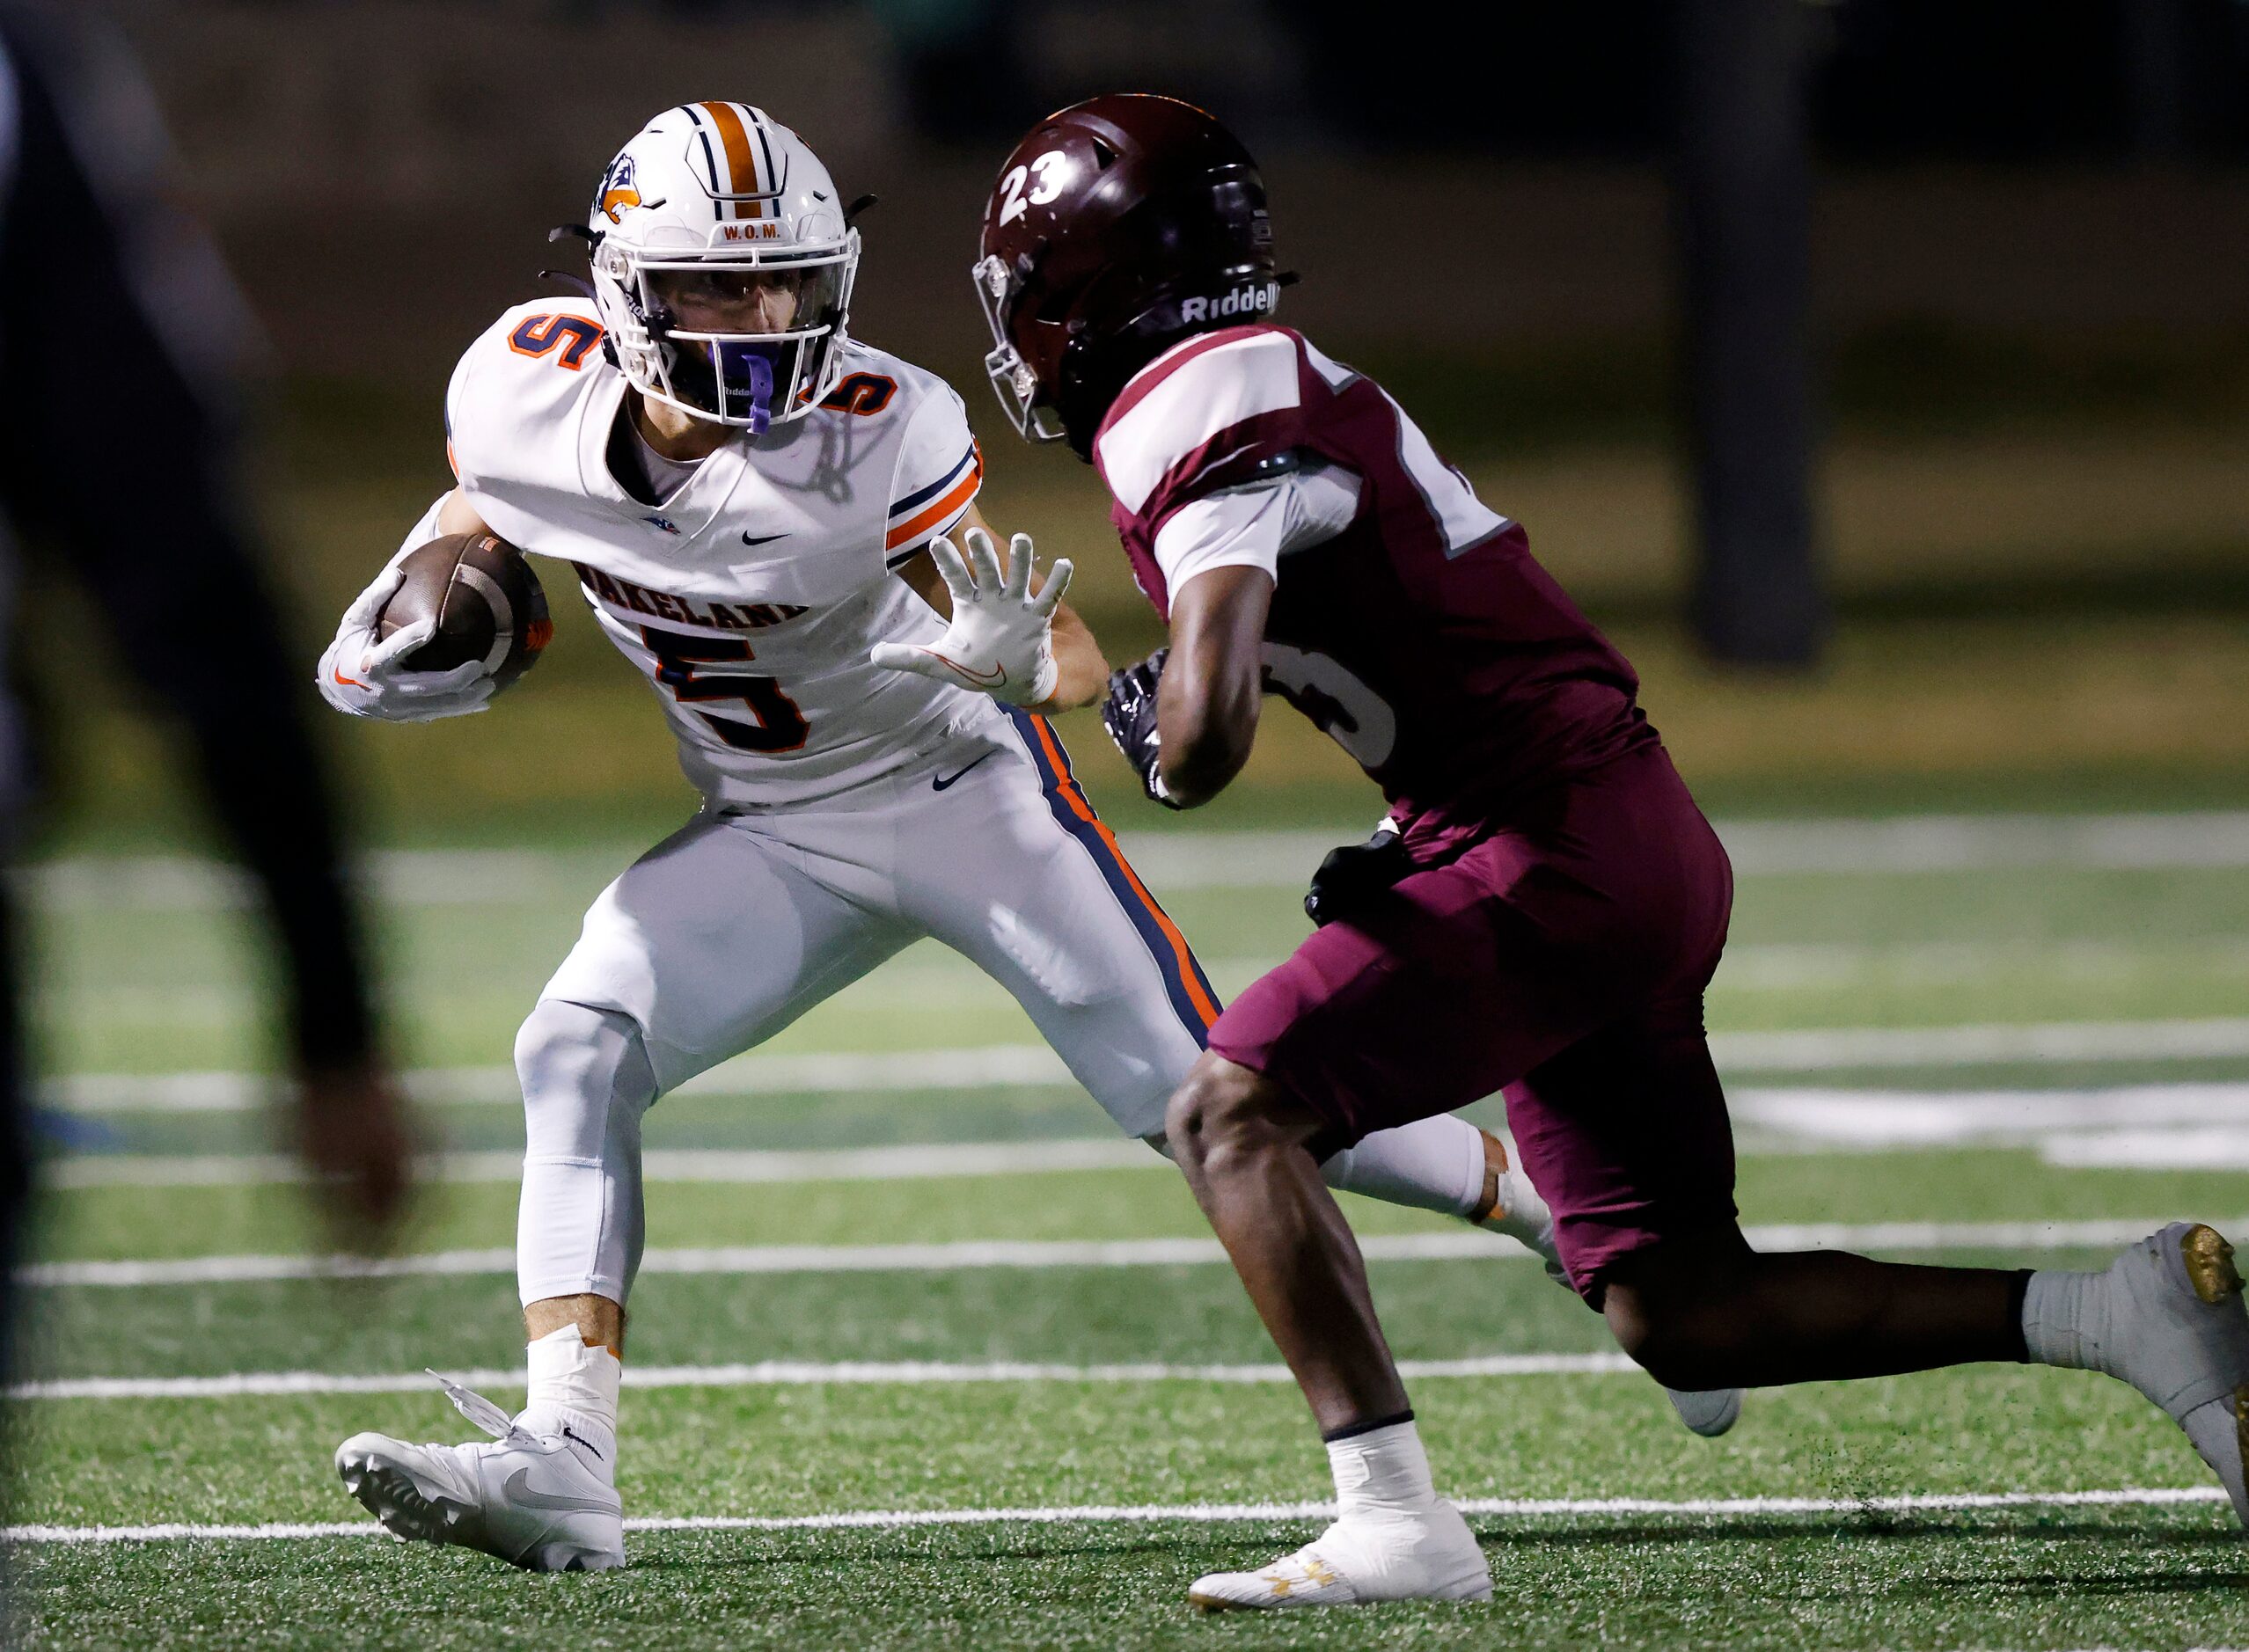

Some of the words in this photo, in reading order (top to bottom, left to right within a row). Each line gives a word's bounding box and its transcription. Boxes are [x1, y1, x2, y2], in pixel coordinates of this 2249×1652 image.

[999, 150, 1066, 227] 23
[1181, 282, 1278, 323] Riddell
[507, 312, 605, 371] 5
[796, 371, 899, 416] 5
[640, 623, 811, 754] 5
